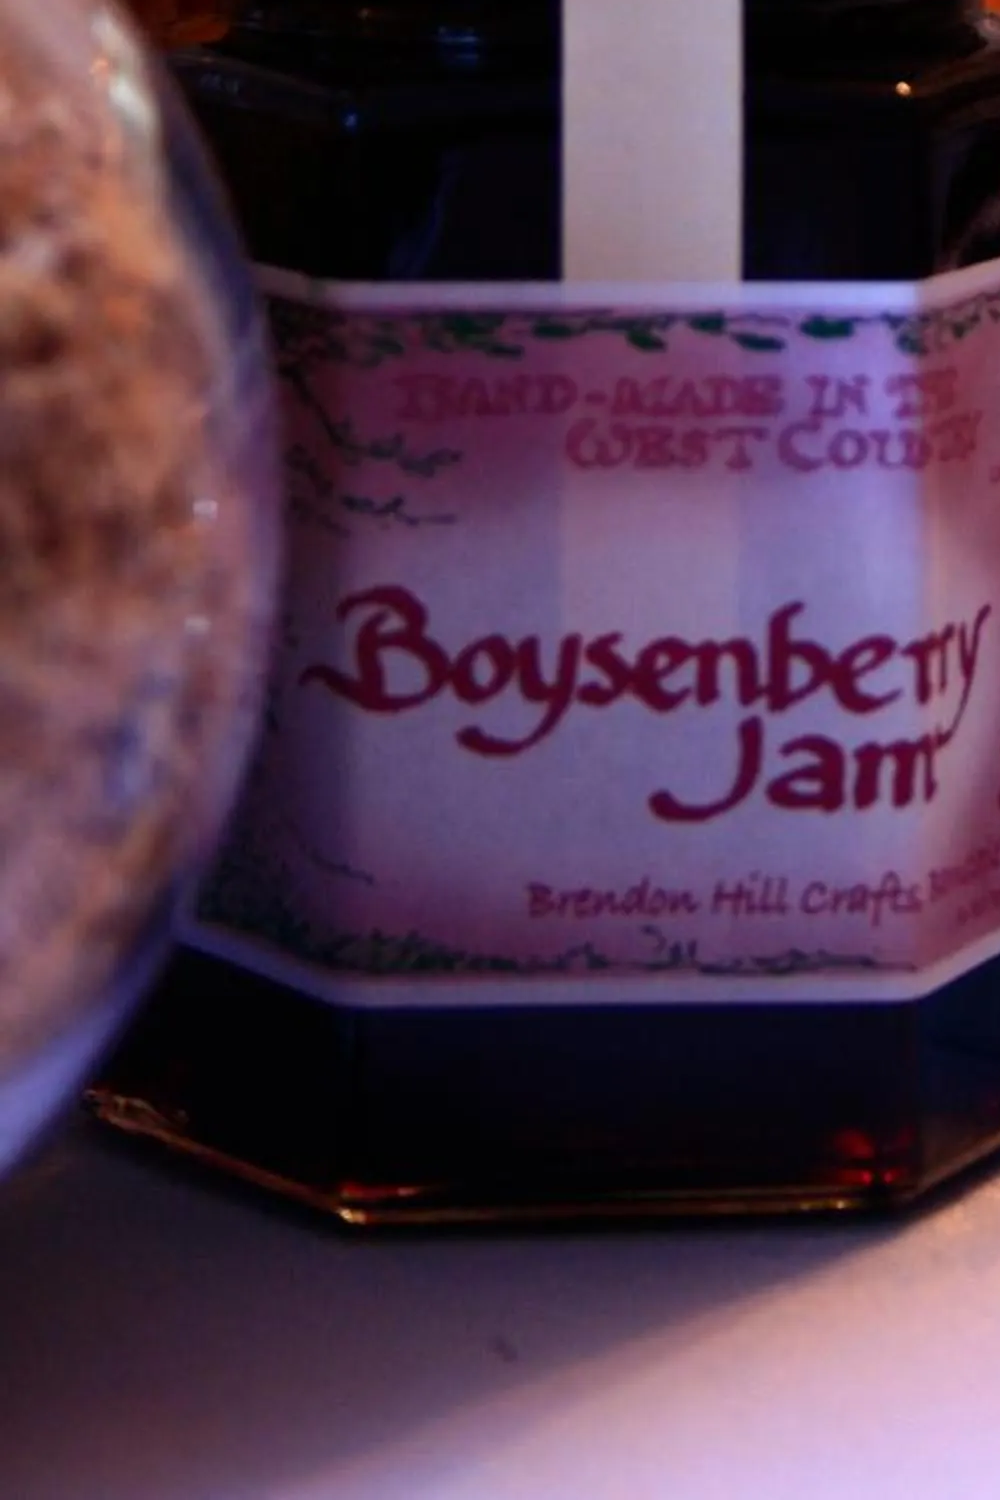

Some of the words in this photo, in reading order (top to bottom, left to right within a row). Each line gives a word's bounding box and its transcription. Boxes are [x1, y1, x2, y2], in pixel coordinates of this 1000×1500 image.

[565, 418, 767, 472] WEST
[299, 585, 993, 756] Boysenberry
[648, 718, 938, 823] Jam
[526, 872, 699, 920] Brendon
[711, 868, 789, 917] Hill
[799, 869, 922, 928] Crafts
